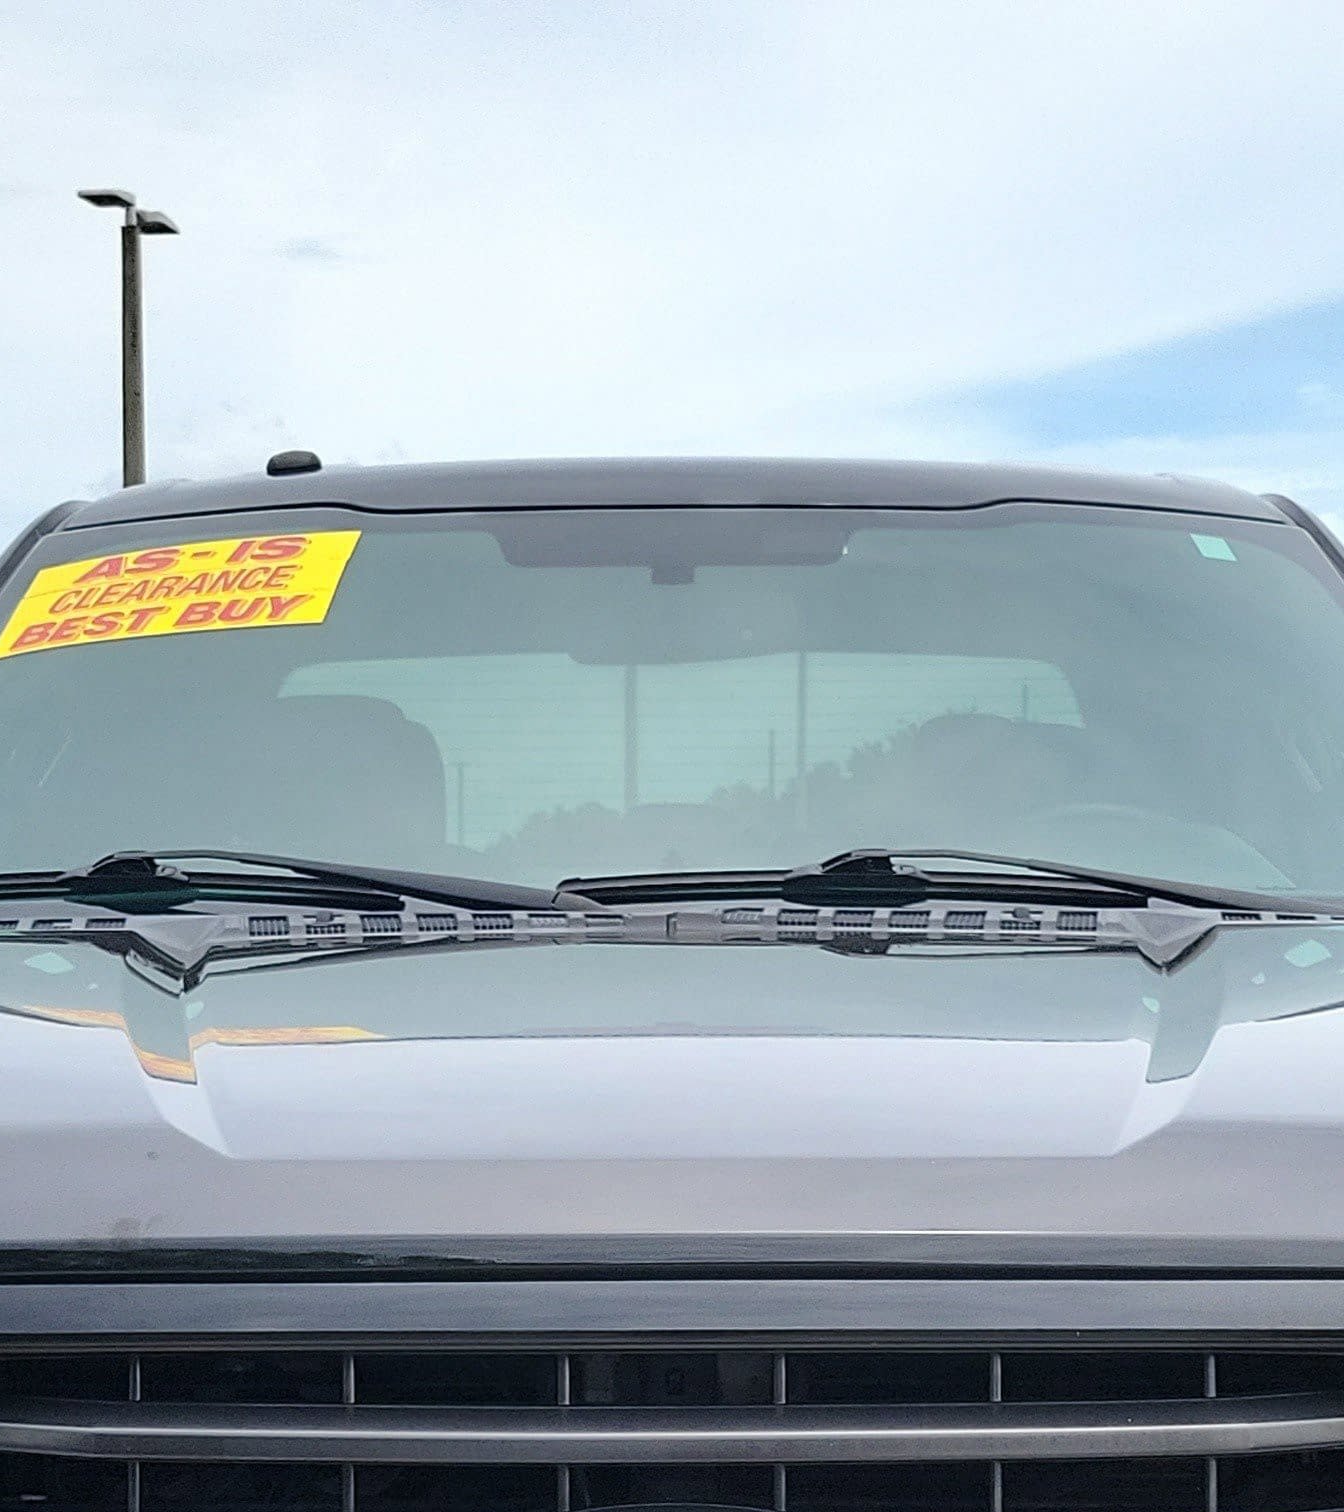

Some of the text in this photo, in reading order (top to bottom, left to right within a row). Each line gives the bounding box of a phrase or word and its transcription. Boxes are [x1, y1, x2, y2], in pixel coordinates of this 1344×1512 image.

[48, 565, 303, 615] CLEARANCE
[9, 594, 315, 652] BEST BUY
